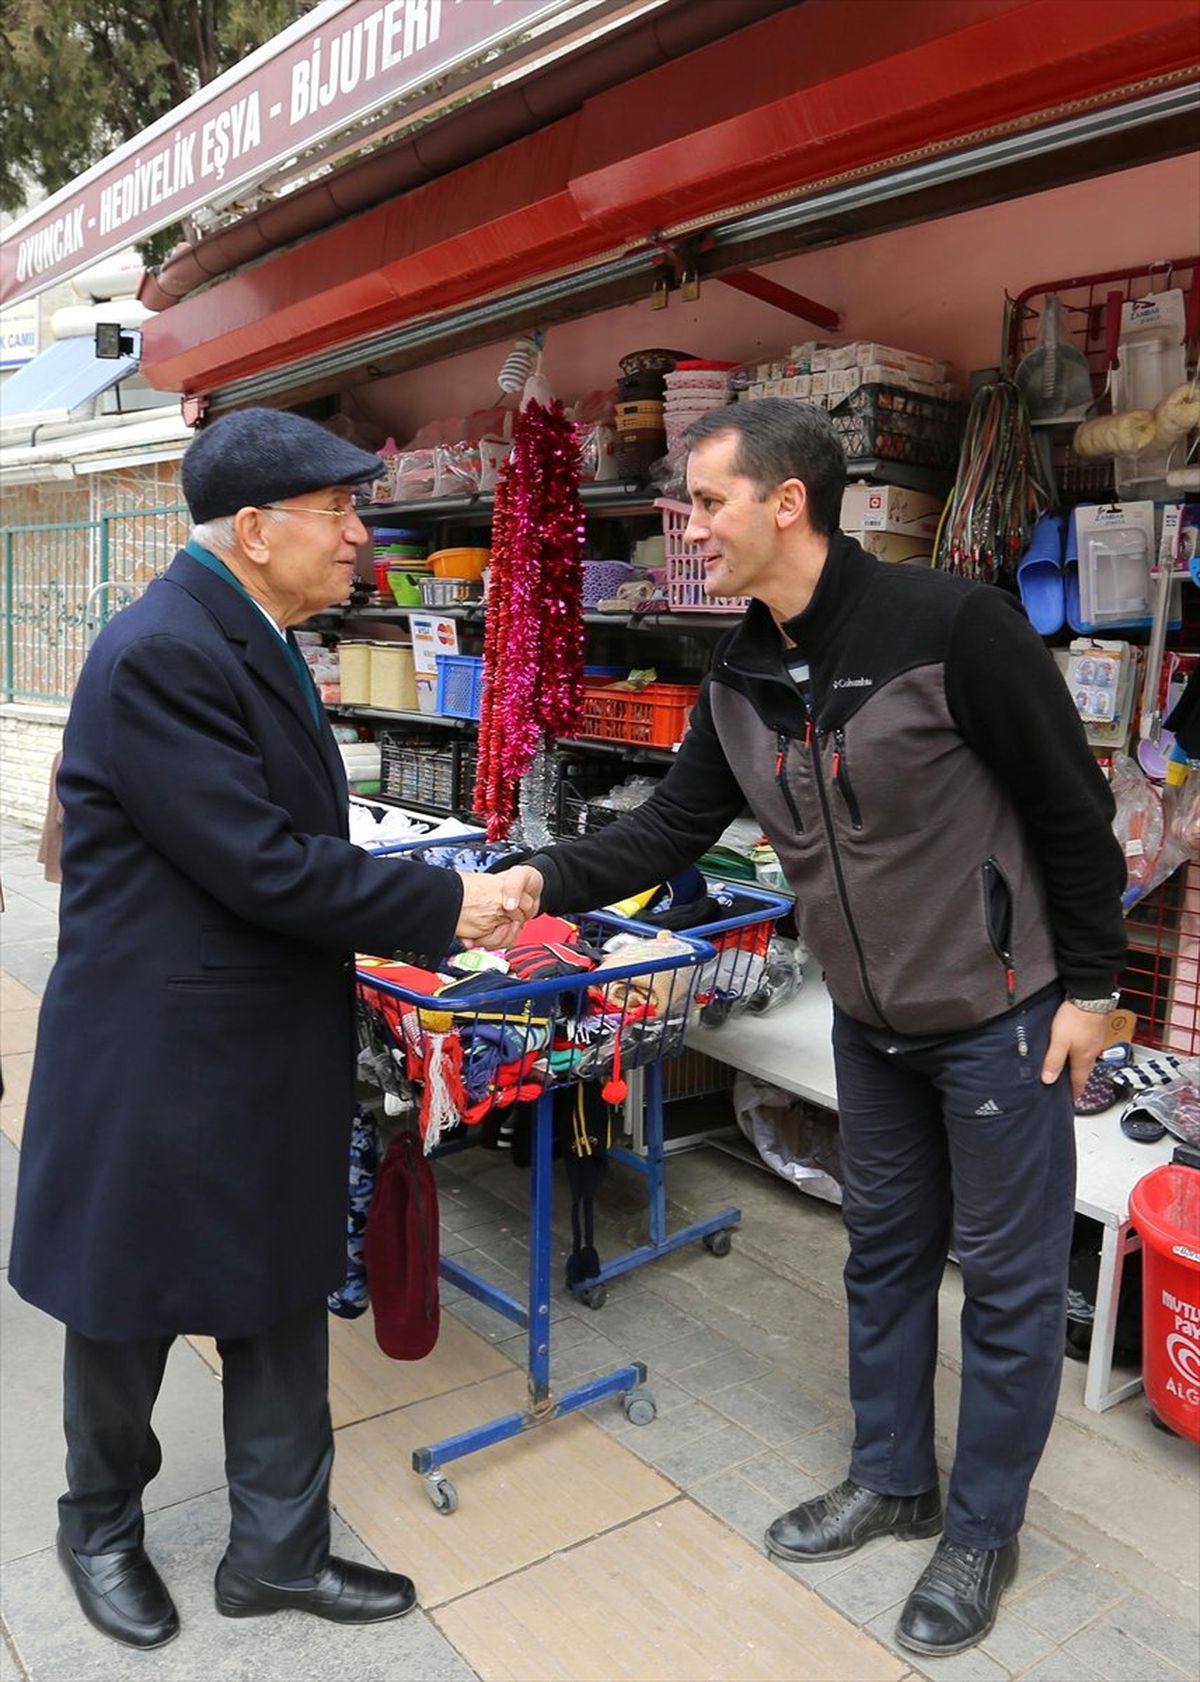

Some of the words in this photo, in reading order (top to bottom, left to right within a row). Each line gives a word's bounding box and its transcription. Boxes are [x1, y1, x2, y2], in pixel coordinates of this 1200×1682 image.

[16, 204, 85, 282] OYUNCAK
[100, 132, 197, 236] HEDİYELİK
[201, 91, 260, 181] EŞYA
